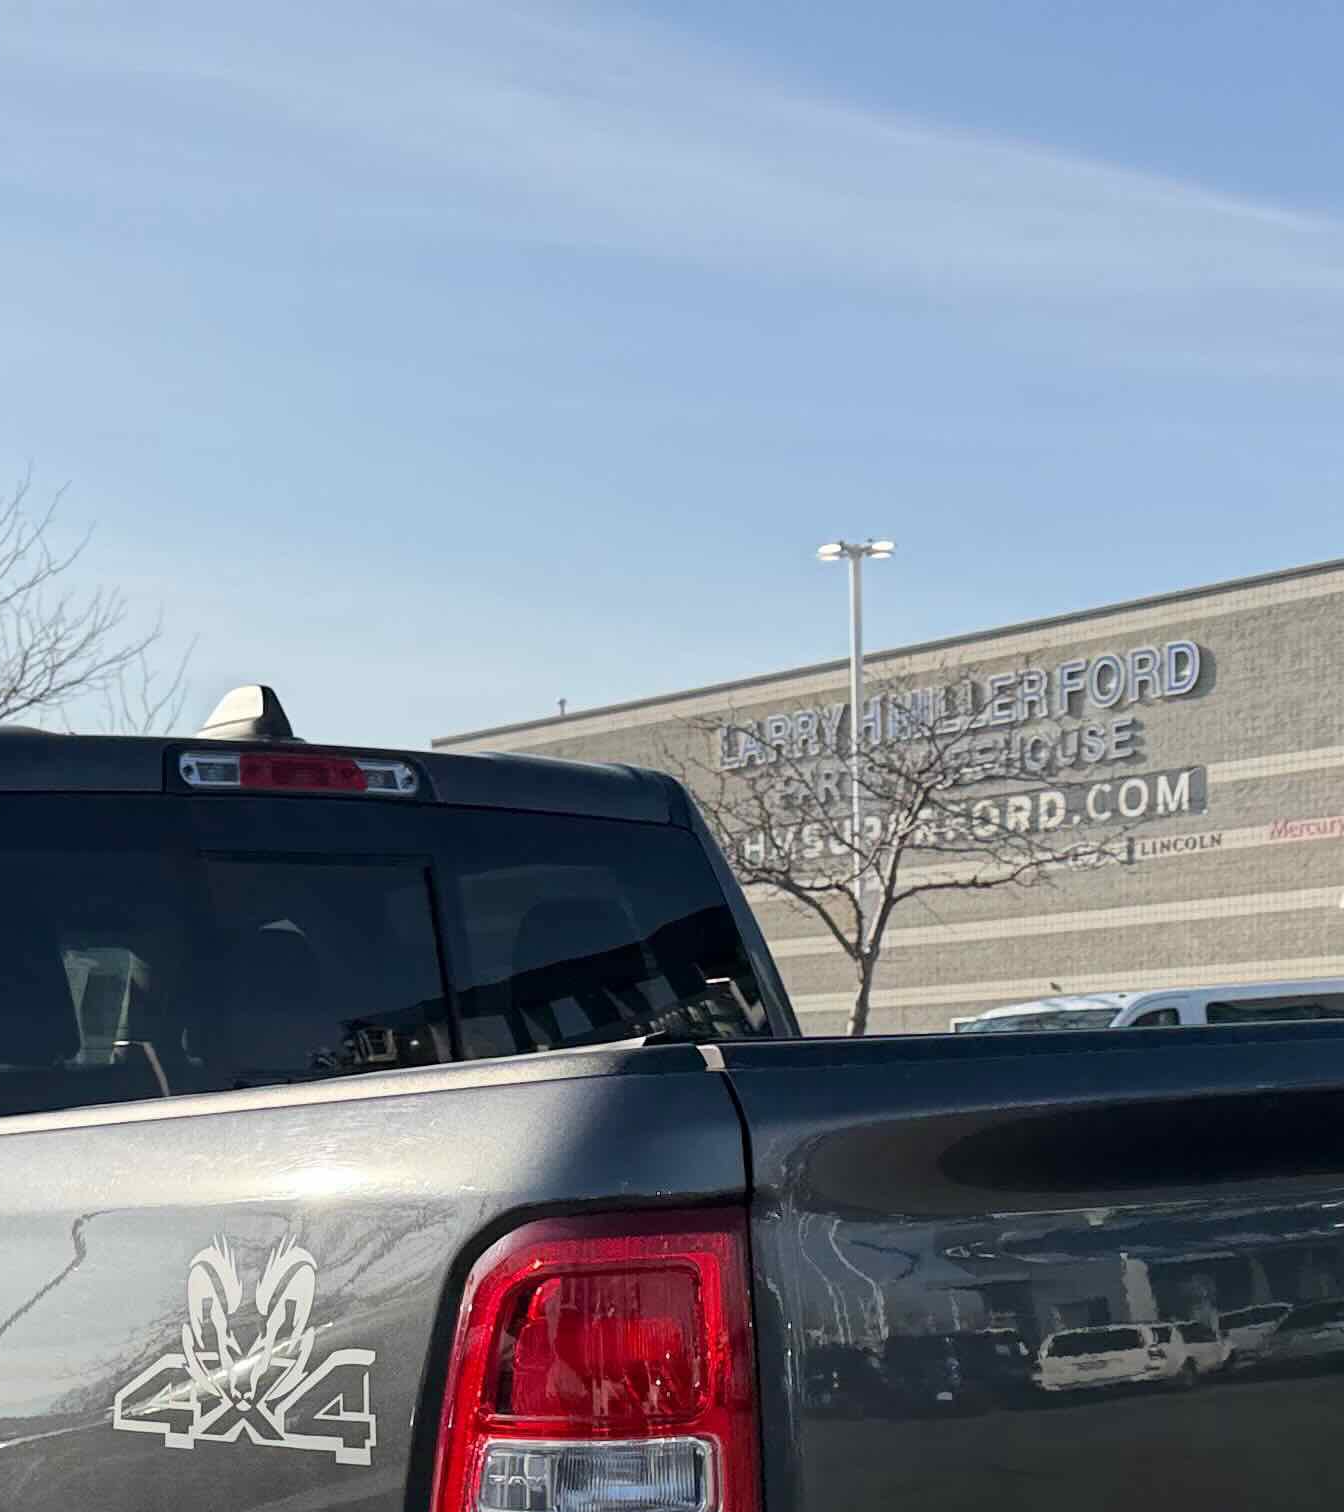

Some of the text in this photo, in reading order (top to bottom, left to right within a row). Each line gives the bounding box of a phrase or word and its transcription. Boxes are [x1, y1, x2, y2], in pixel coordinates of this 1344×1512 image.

[719, 704, 846, 769] LARRY
[1057, 640, 1201, 716] FORD
[1141, 833, 1222, 856] LINCOLN
